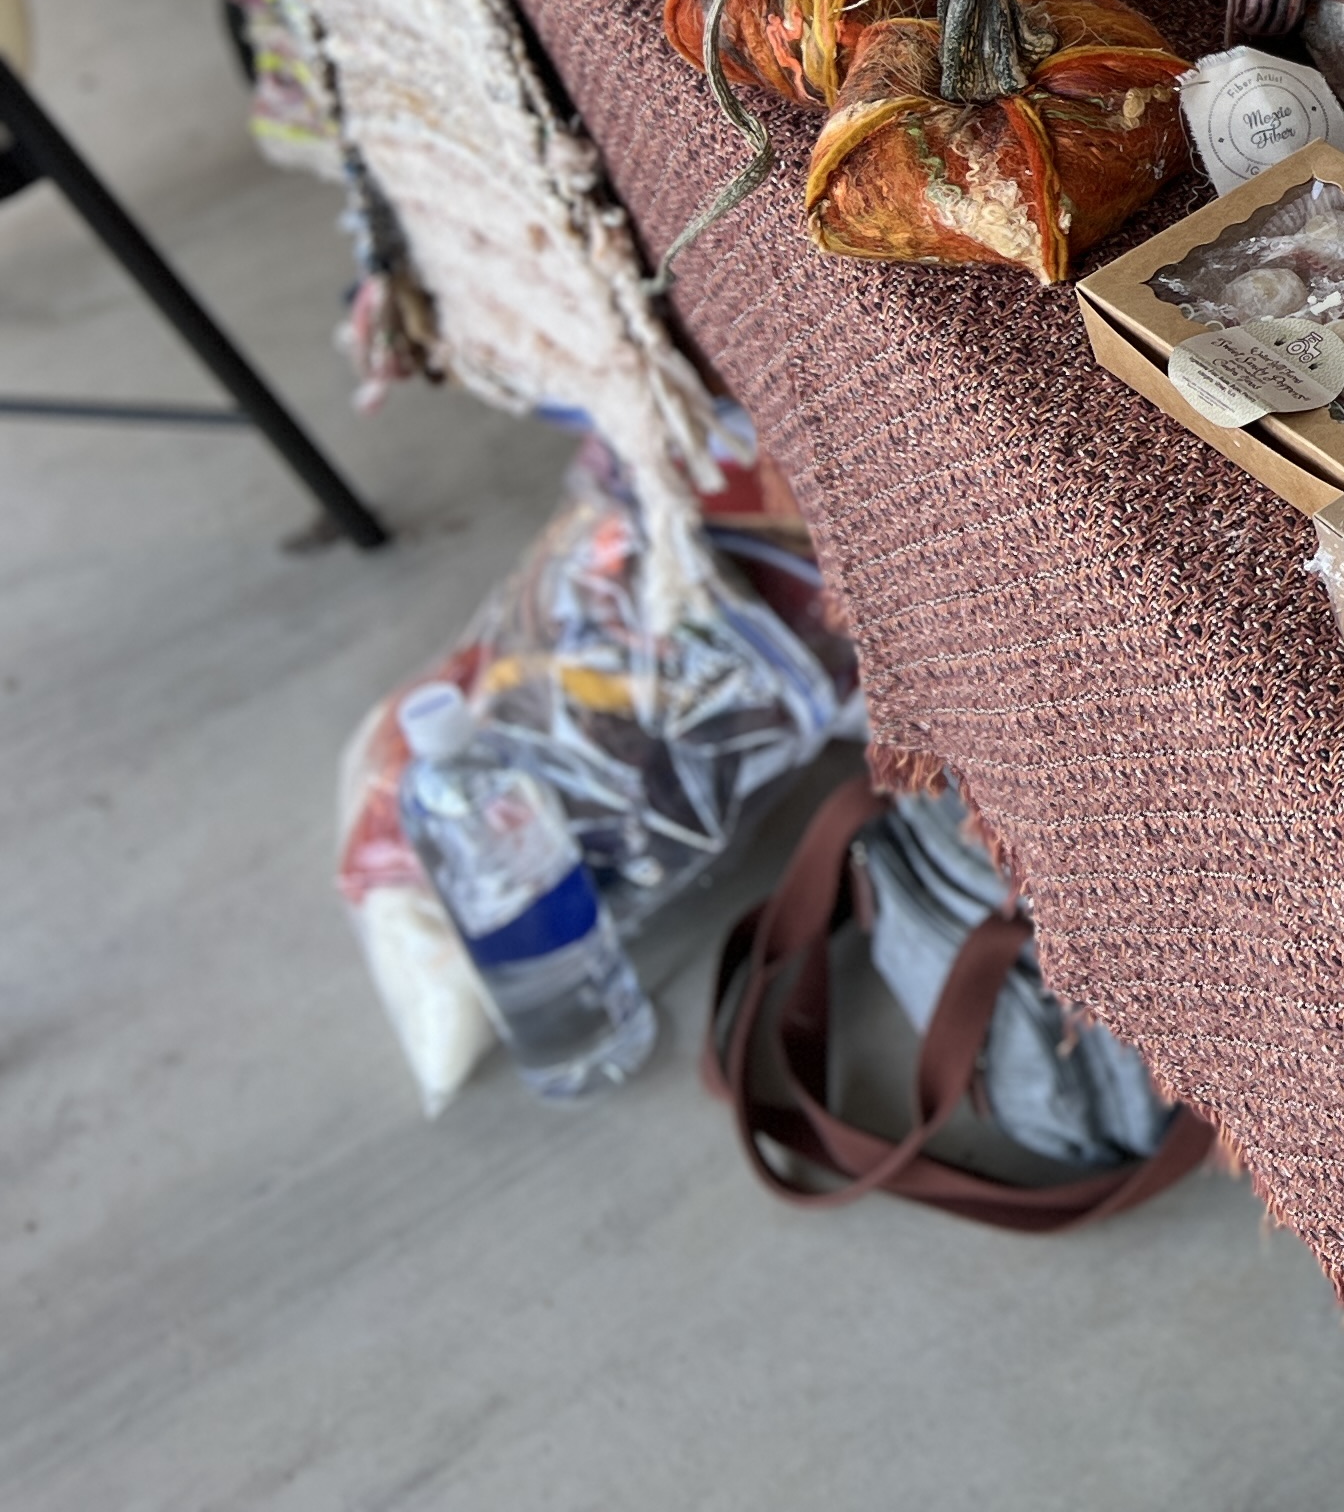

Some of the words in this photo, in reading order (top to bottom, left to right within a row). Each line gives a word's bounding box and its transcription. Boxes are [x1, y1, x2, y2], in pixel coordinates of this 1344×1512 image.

[1226, 77, 1253, 99] Fiber
[1256, 72, 1284, 84] Artist
[1243, 105, 1292, 130] Moxie
[1250, 124, 1296, 149] Fiber
